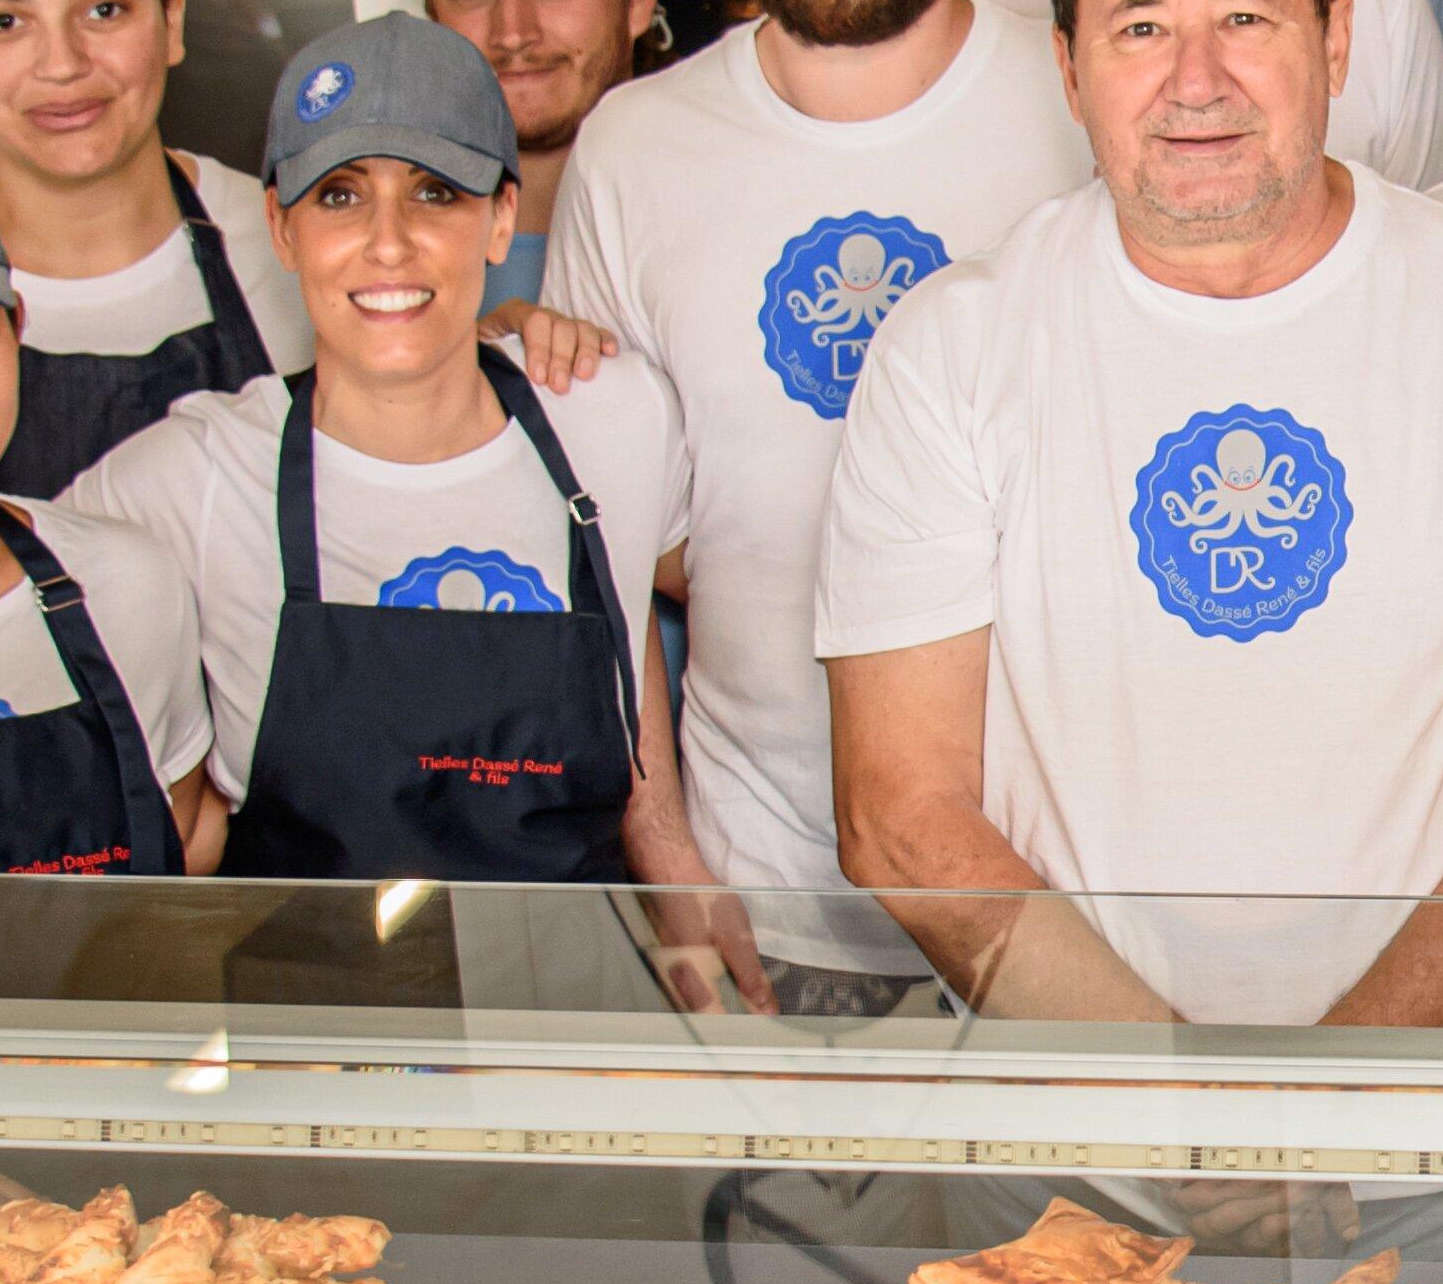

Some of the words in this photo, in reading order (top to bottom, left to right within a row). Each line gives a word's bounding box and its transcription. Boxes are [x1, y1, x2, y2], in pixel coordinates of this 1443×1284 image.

[832, 339, 872, 381] D
[1161, 554, 1200, 608] Tielles
[1202, 599, 1252, 620] Dassé
[1256, 587, 1296, 616] René
[1296, 573, 1313, 590] &
[1305, 547, 1328, 573] fils
[1210, 545, 1276, 594] DR
[419, 754, 469, 771] Tielles
[472, 755, 520, 774] Dassé
[523, 758, 563, 775] René
[486, 771, 510, 786] fils
